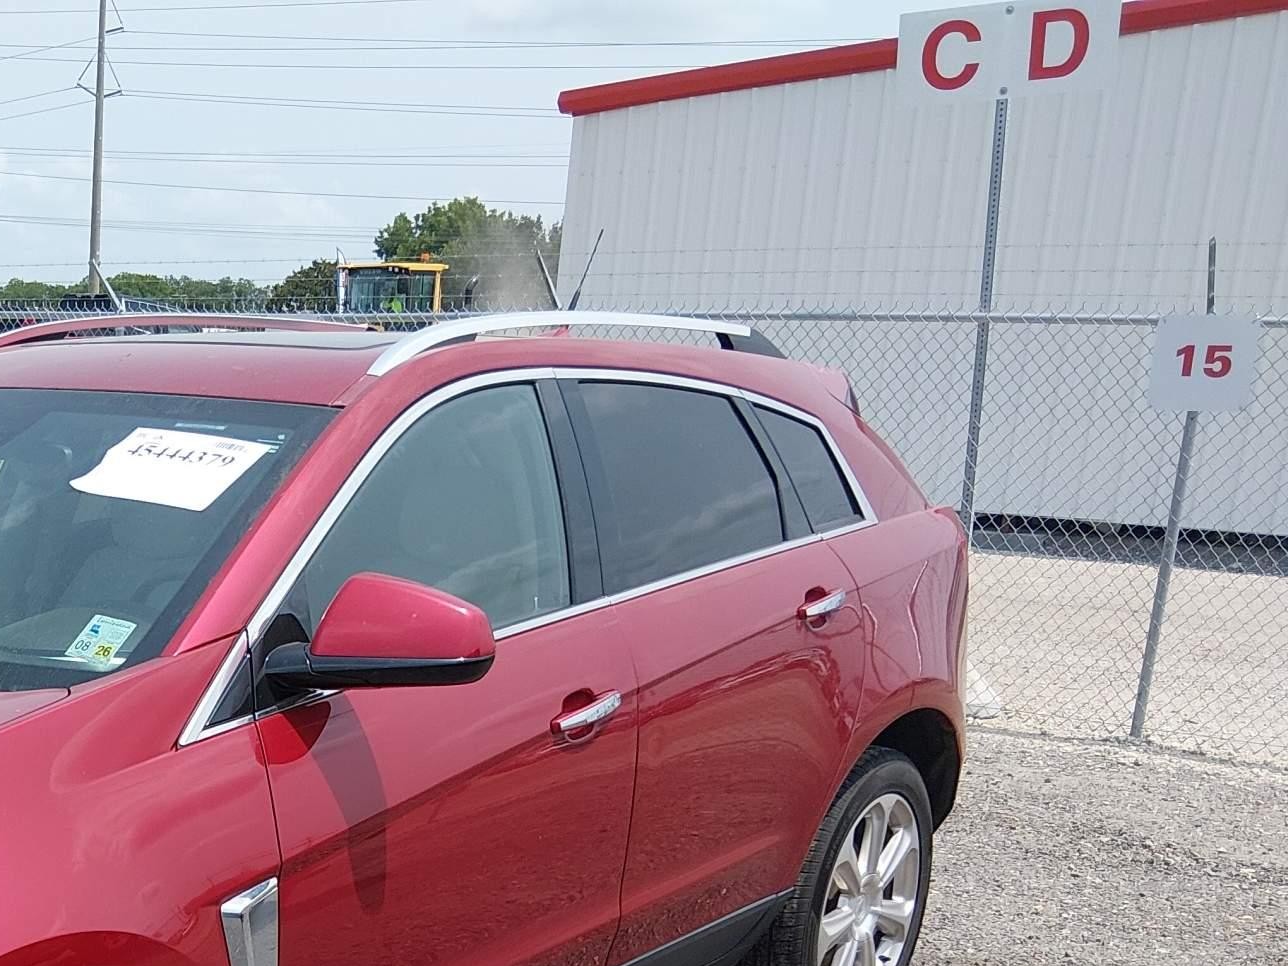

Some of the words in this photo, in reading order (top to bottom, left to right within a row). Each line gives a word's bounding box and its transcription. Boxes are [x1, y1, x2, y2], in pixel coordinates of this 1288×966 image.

[922, 20, 982, 90] C
[1028, 8, 1090, 81] D
[1176, 345, 1233, 378] 15
[128, 443, 235, 467] 45444379
[75, 640, 92, 652] 08
[95, 645, 113, 657] 26
